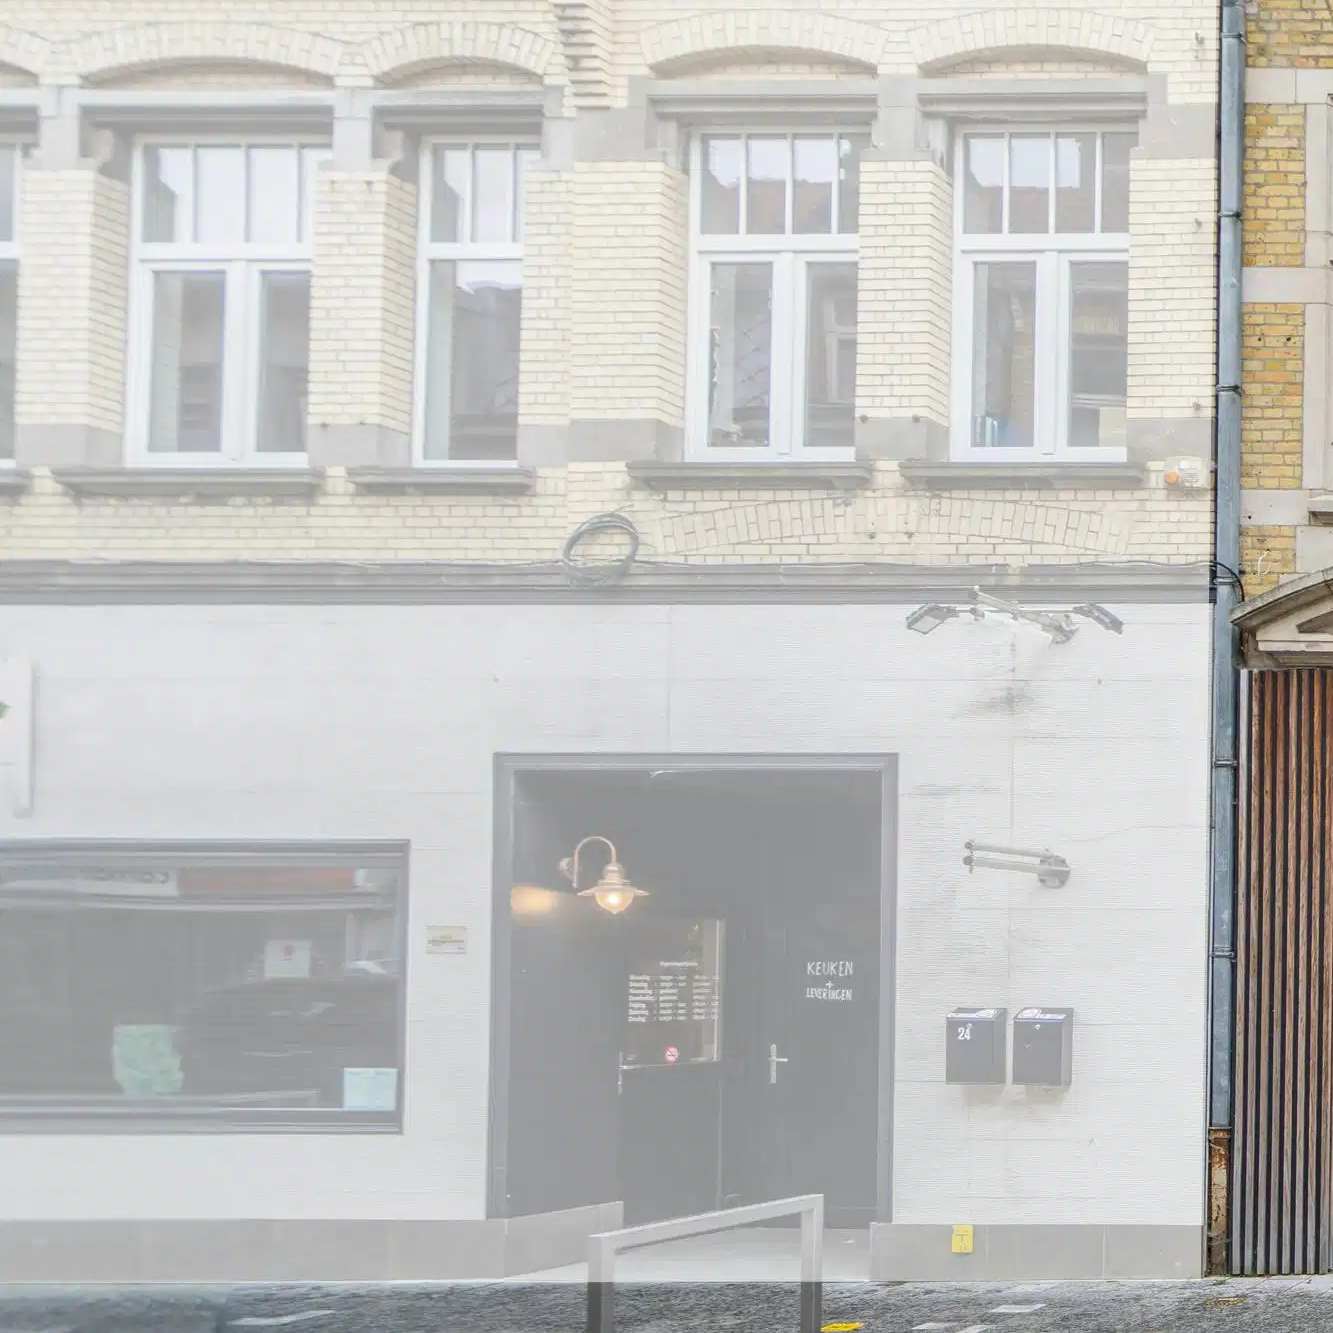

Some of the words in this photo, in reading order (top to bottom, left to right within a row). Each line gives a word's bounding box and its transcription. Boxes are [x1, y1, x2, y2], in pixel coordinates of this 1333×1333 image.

[807, 961, 853, 977] KEUKEN
[806, 987, 853, 1001] LEVERINGEN
[957, 1025, 971, 1041] 24
